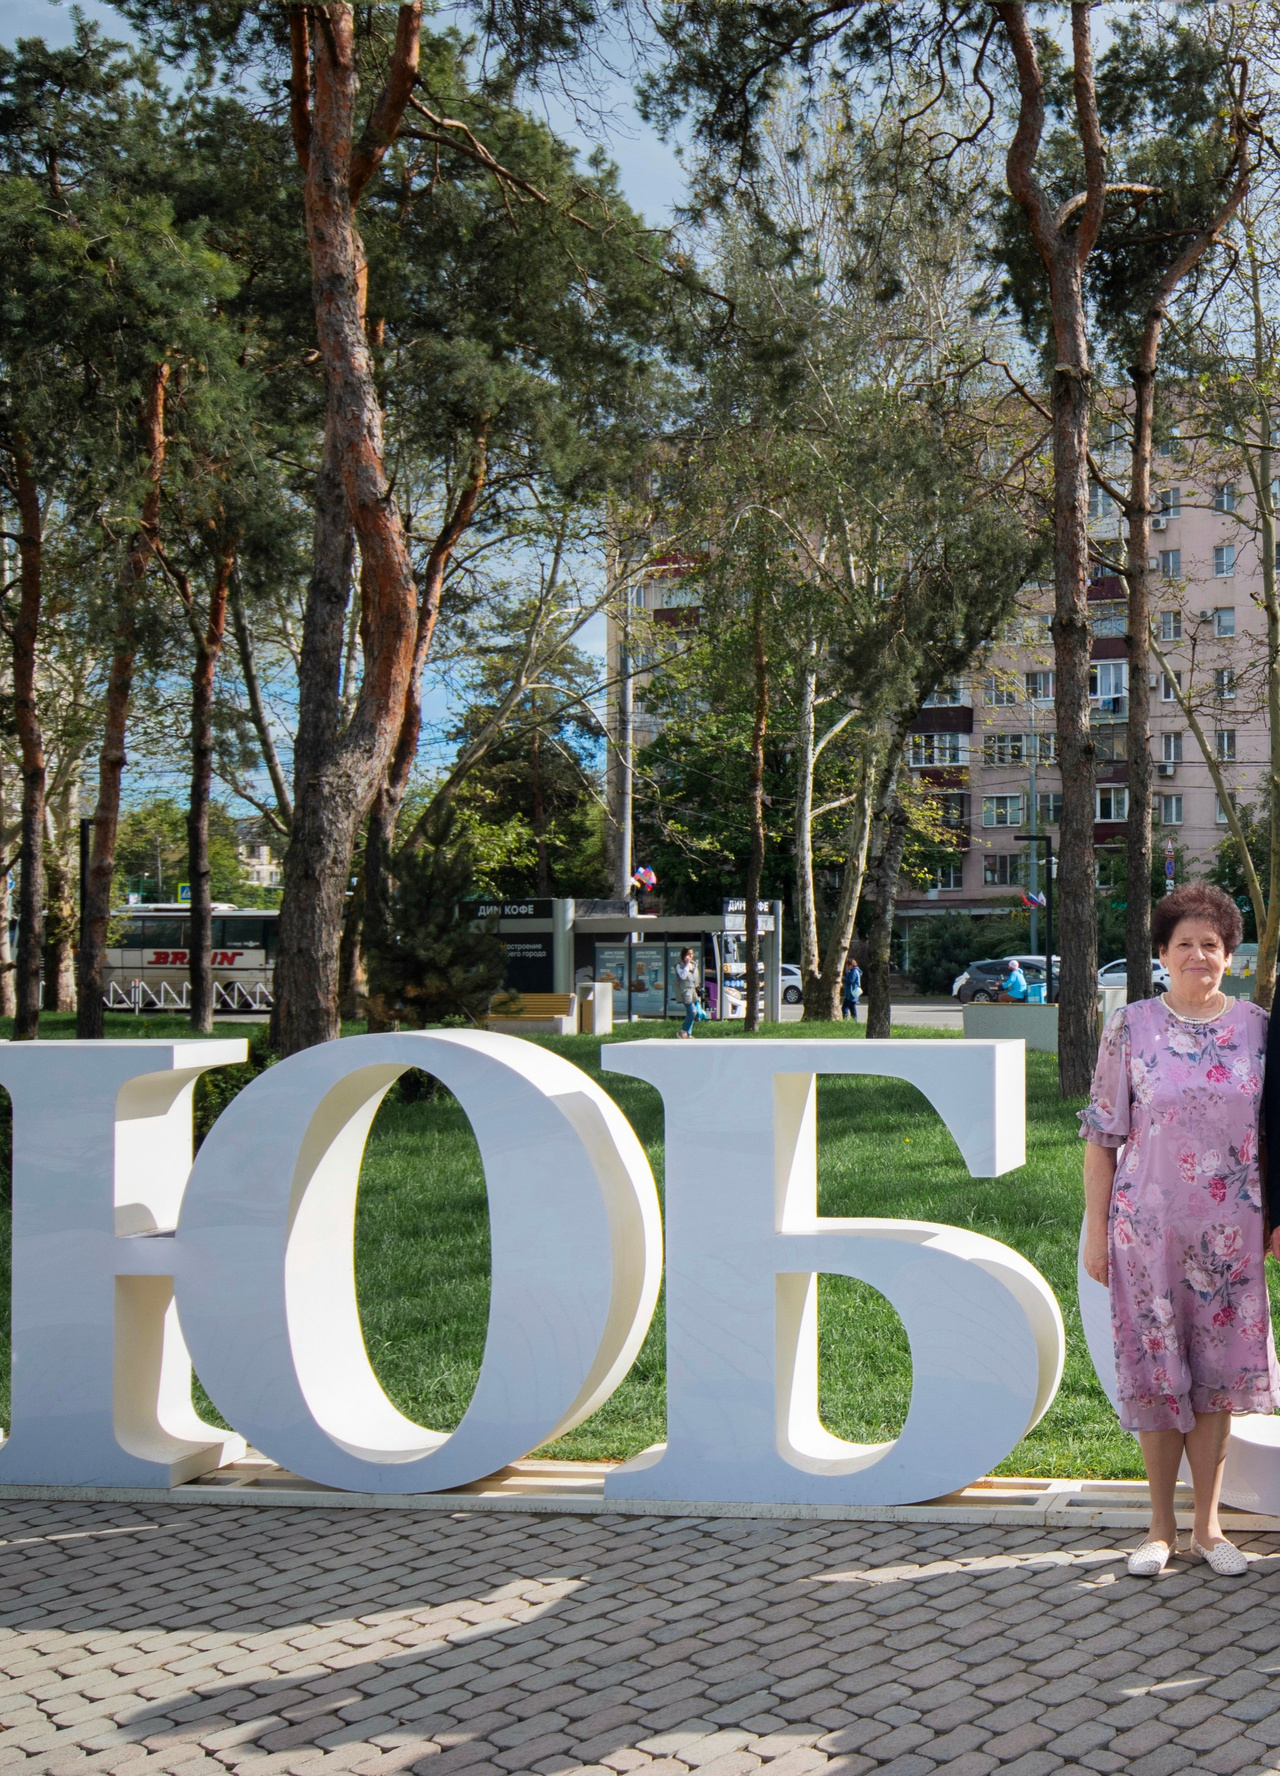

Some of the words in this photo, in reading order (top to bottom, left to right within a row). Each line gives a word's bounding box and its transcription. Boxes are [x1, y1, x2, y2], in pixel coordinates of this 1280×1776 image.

[478, 905, 502, 917] ДИМ
[504, 904, 535, 915] КОФЕ
[147, 951, 244, 966] BRN
[522, 951, 547, 959] города
